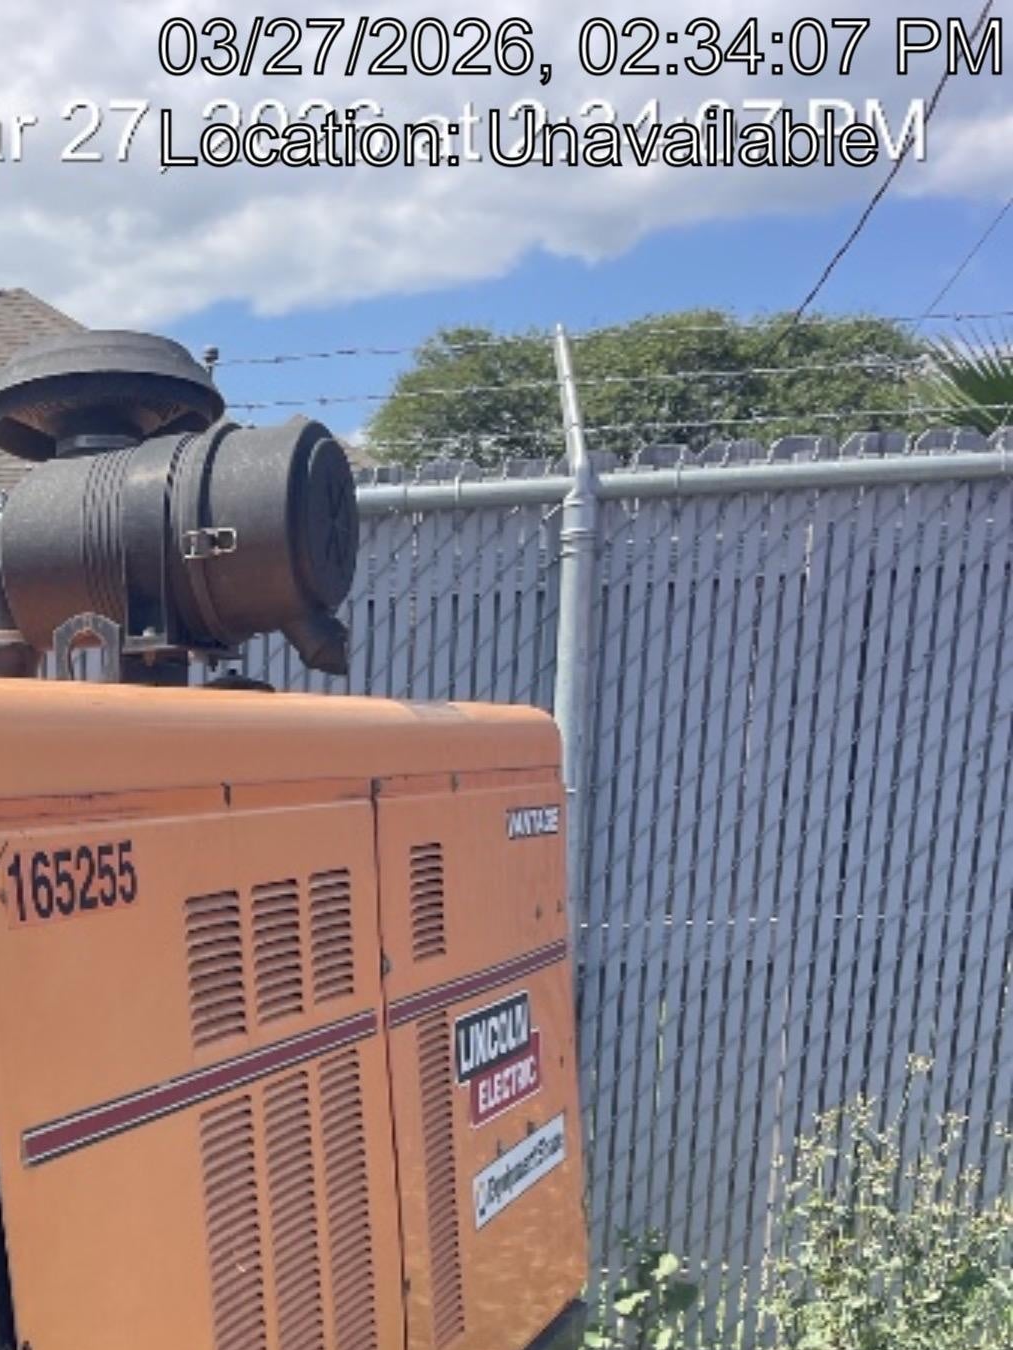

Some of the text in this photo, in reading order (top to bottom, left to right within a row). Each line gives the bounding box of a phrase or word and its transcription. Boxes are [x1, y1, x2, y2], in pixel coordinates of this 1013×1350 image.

[7, 839, 138, 922] 165255
[459, 1003, 530, 1075] LINCOLN
[478, 1055, 538, 1115] ELECTRIC
